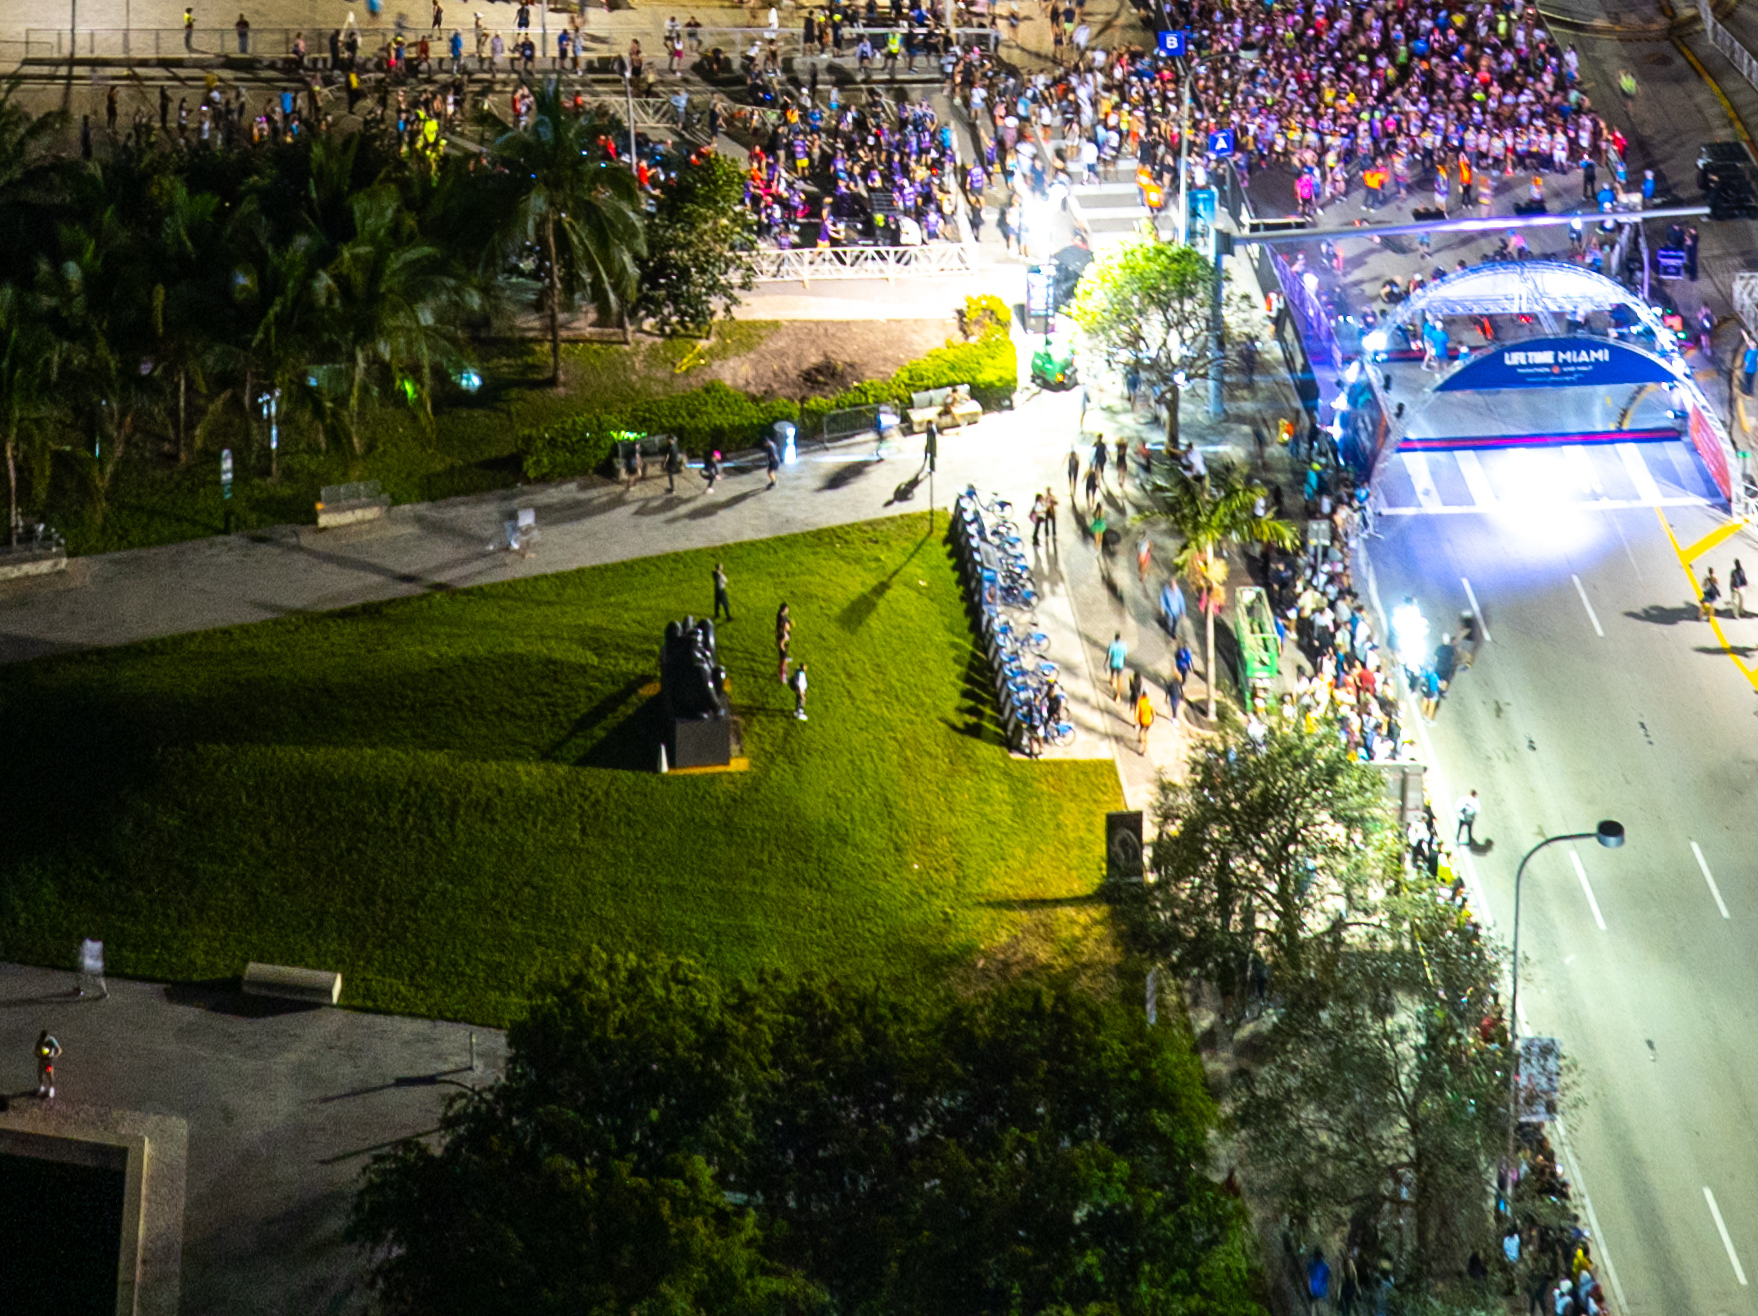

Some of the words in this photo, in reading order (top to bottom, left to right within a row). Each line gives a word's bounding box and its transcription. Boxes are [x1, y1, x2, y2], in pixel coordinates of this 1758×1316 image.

[1165, 36, 1178, 49] B
[1215, 136, 1228, 150] A
[1558, 348, 1610, 364] MIAMI
